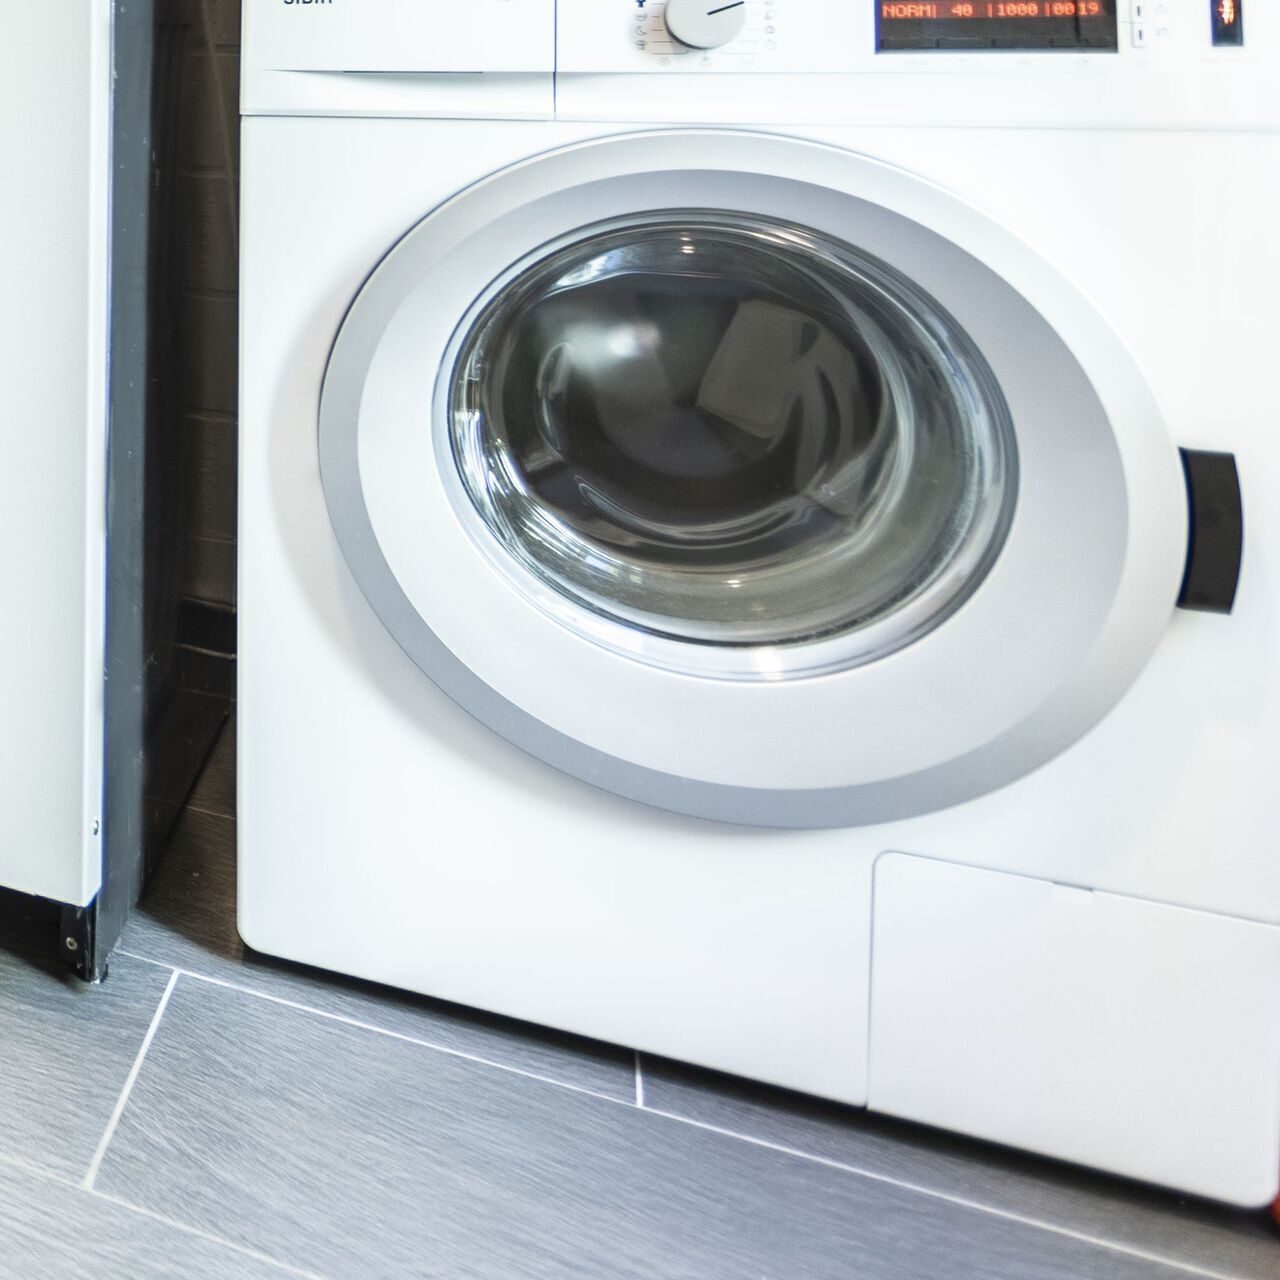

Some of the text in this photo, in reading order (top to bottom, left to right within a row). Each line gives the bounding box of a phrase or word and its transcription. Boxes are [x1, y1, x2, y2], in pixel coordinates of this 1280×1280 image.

[882, 3, 931, 19] NORM
[951, 3, 973, 17] 40
[997, 2, 1038, 17] 1000
